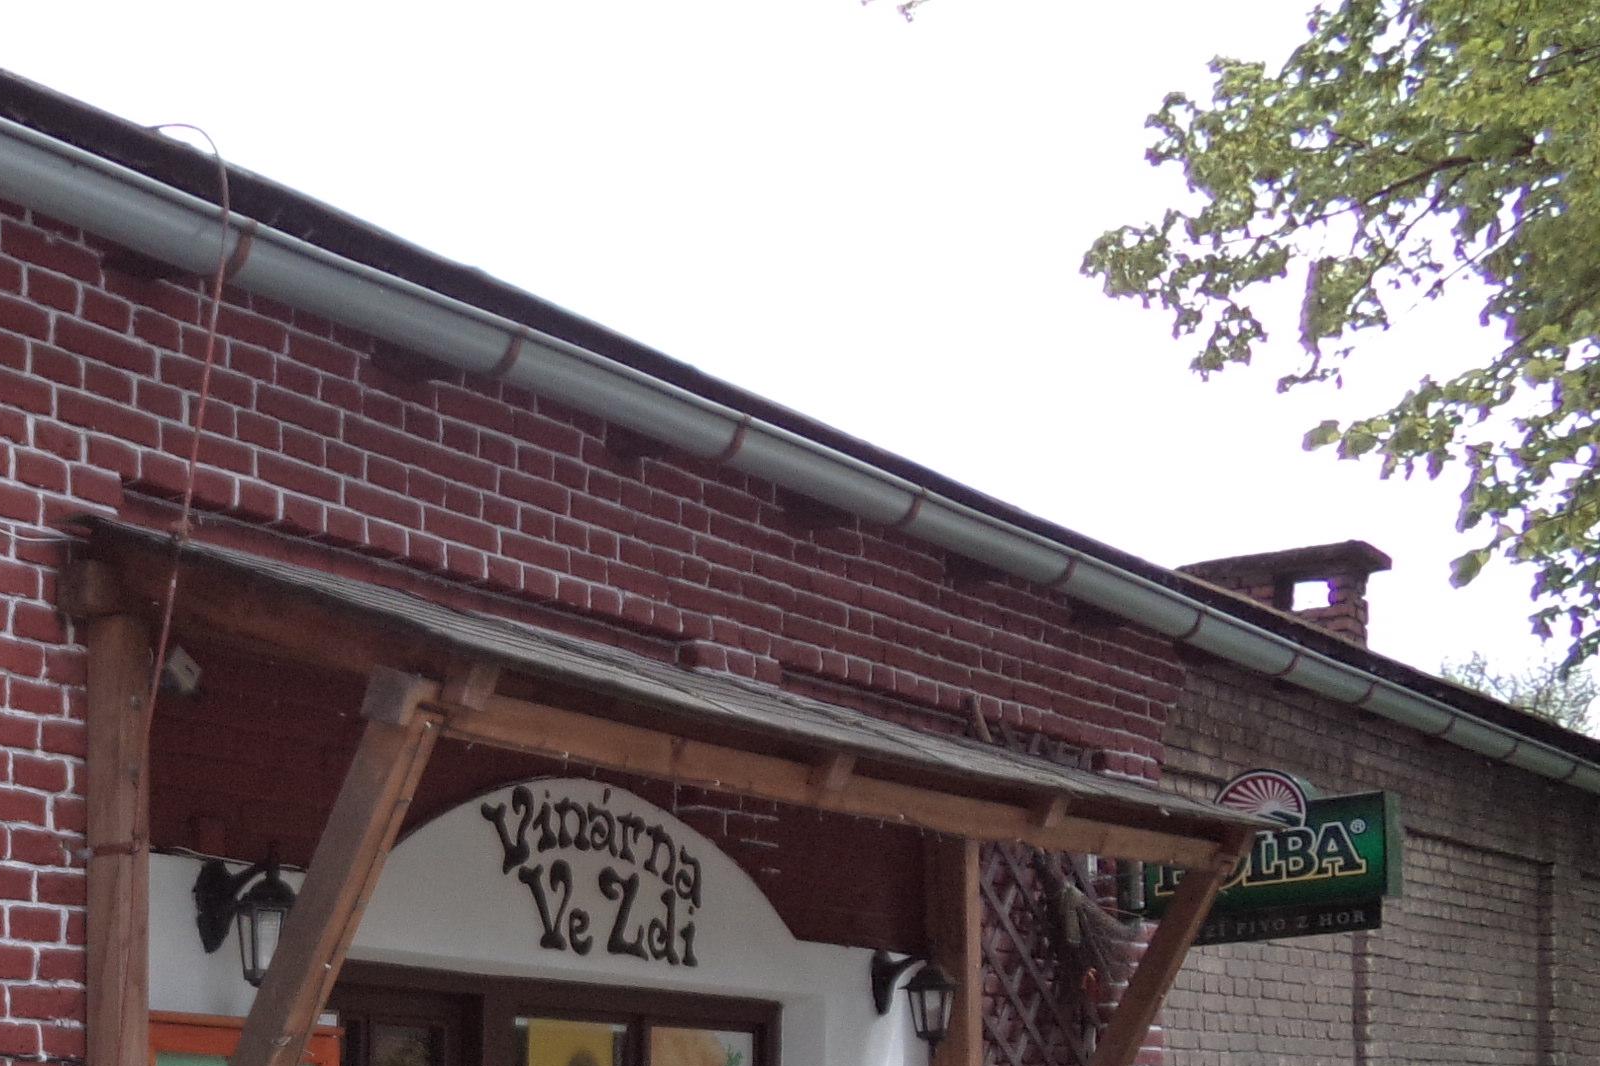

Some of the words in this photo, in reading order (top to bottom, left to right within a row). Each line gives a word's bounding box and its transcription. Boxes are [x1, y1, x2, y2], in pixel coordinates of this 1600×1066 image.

[480, 785, 702, 908] Vinárna
[518, 859, 594, 956] Ve
[598, 866, 698, 967] Zdi
